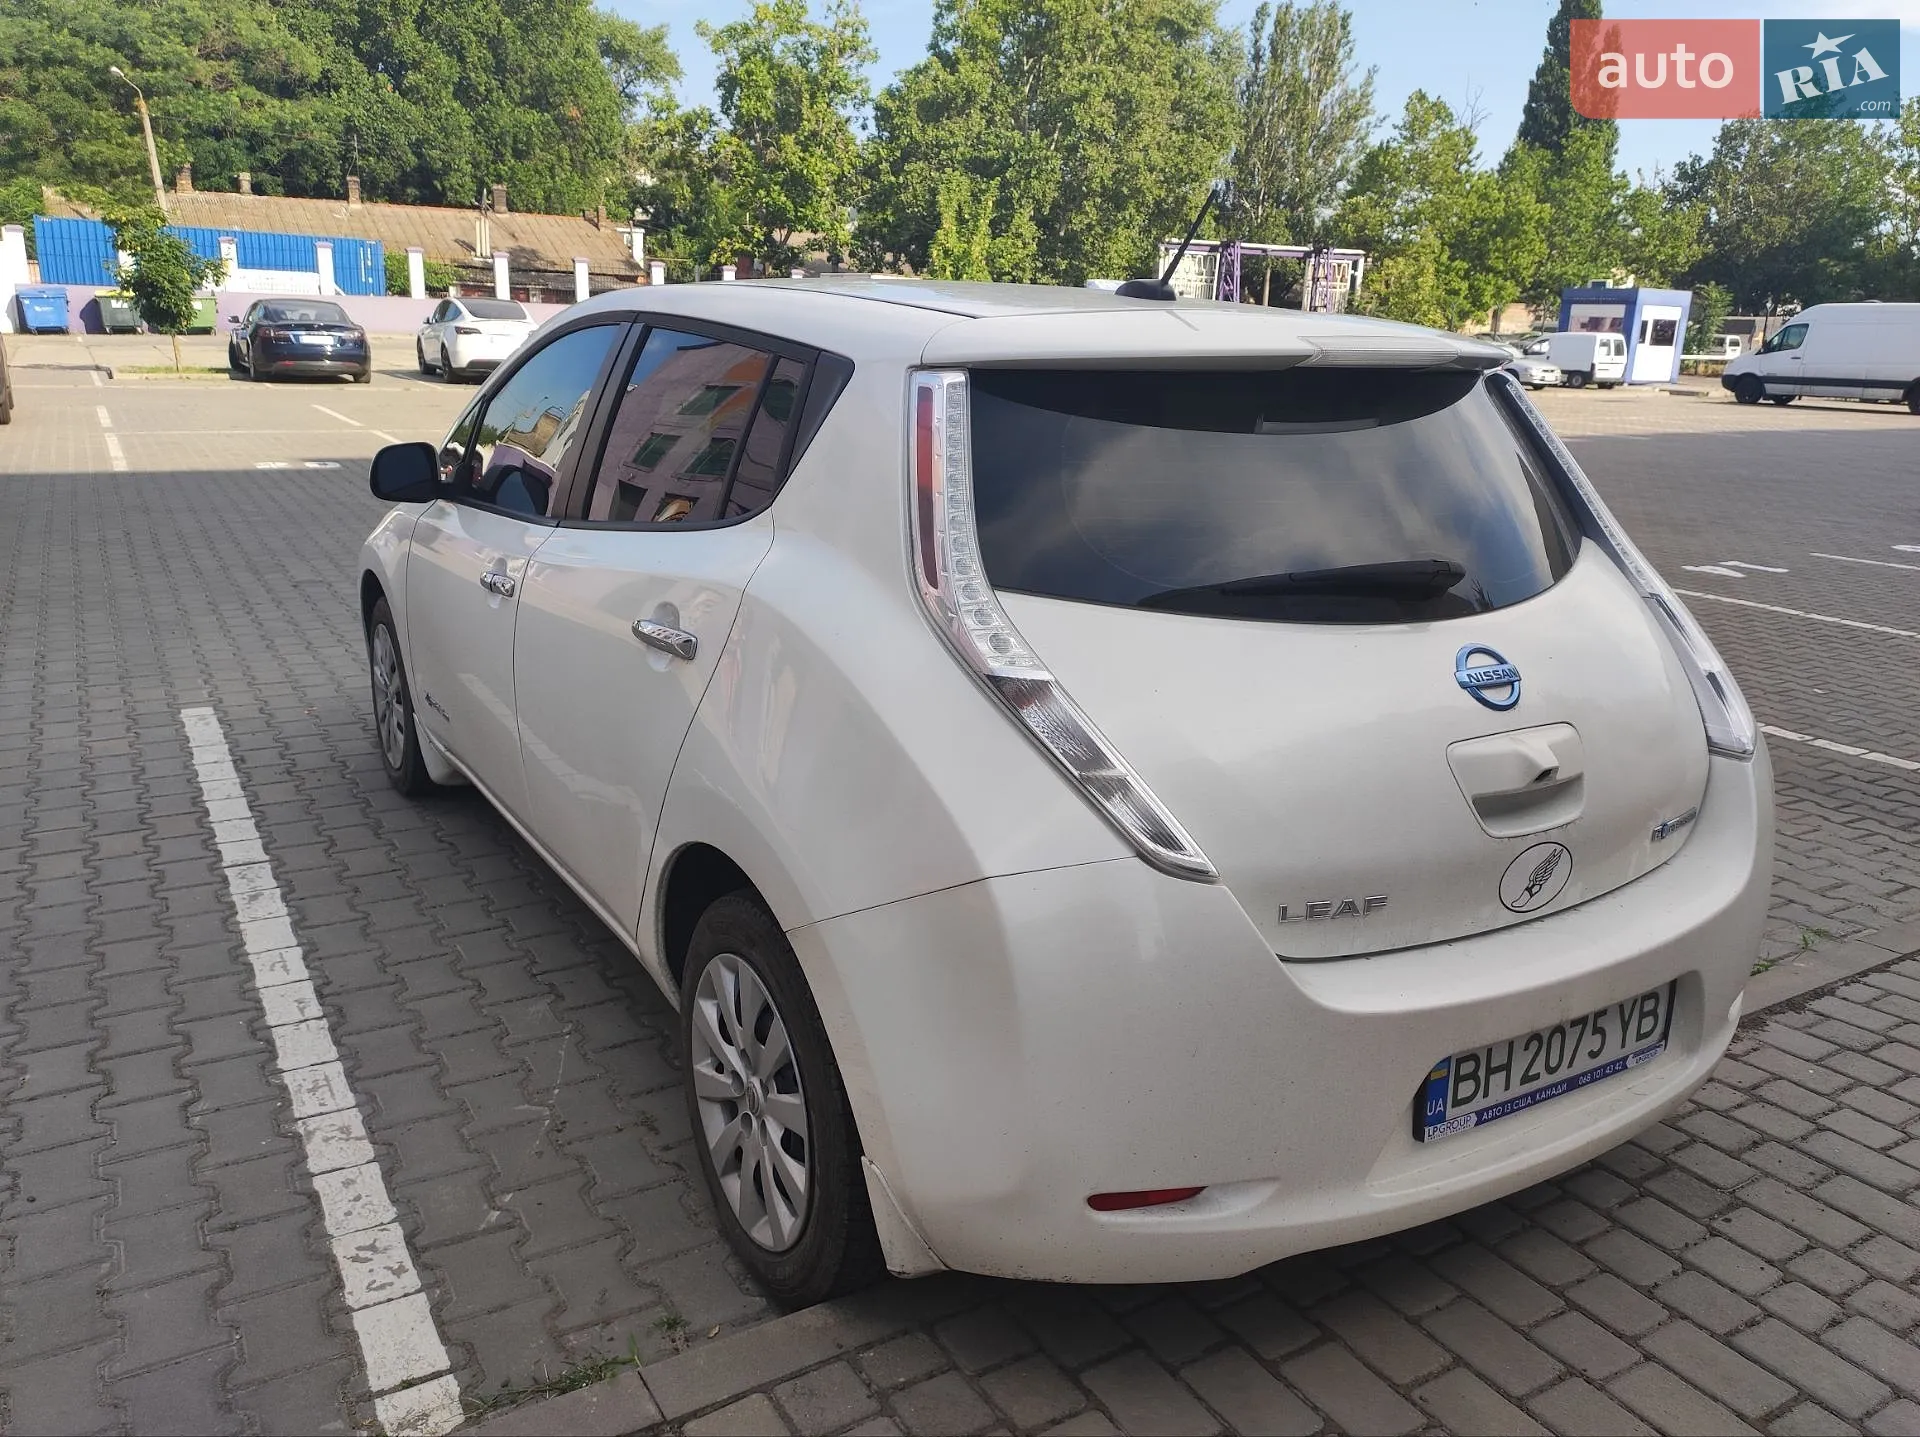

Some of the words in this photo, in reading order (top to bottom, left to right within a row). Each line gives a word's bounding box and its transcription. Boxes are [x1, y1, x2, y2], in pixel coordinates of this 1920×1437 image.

[1466, 668, 1519, 684] NISSAN
[1278, 895, 1389, 924] LEAF
[1450, 1040, 1514, 1108] BH
[1520, 1009, 1609, 1086] 2075
[1618, 991, 1661, 1050] YB
[1578, 1073, 1592, 1085] 068
[1593, 1068, 1604, 1080] 101
[1605, 1064, 1614, 1075] 43
[1614, 1061, 1624, 1071] 42
[1427, 1097, 1445, 1116] UA
[1481, 1106, 1503, 1121] АВТО
[1536, 1082, 1568, 1102] КАНАДИ
[1427, 1115, 1472, 1138] LPGROUP
